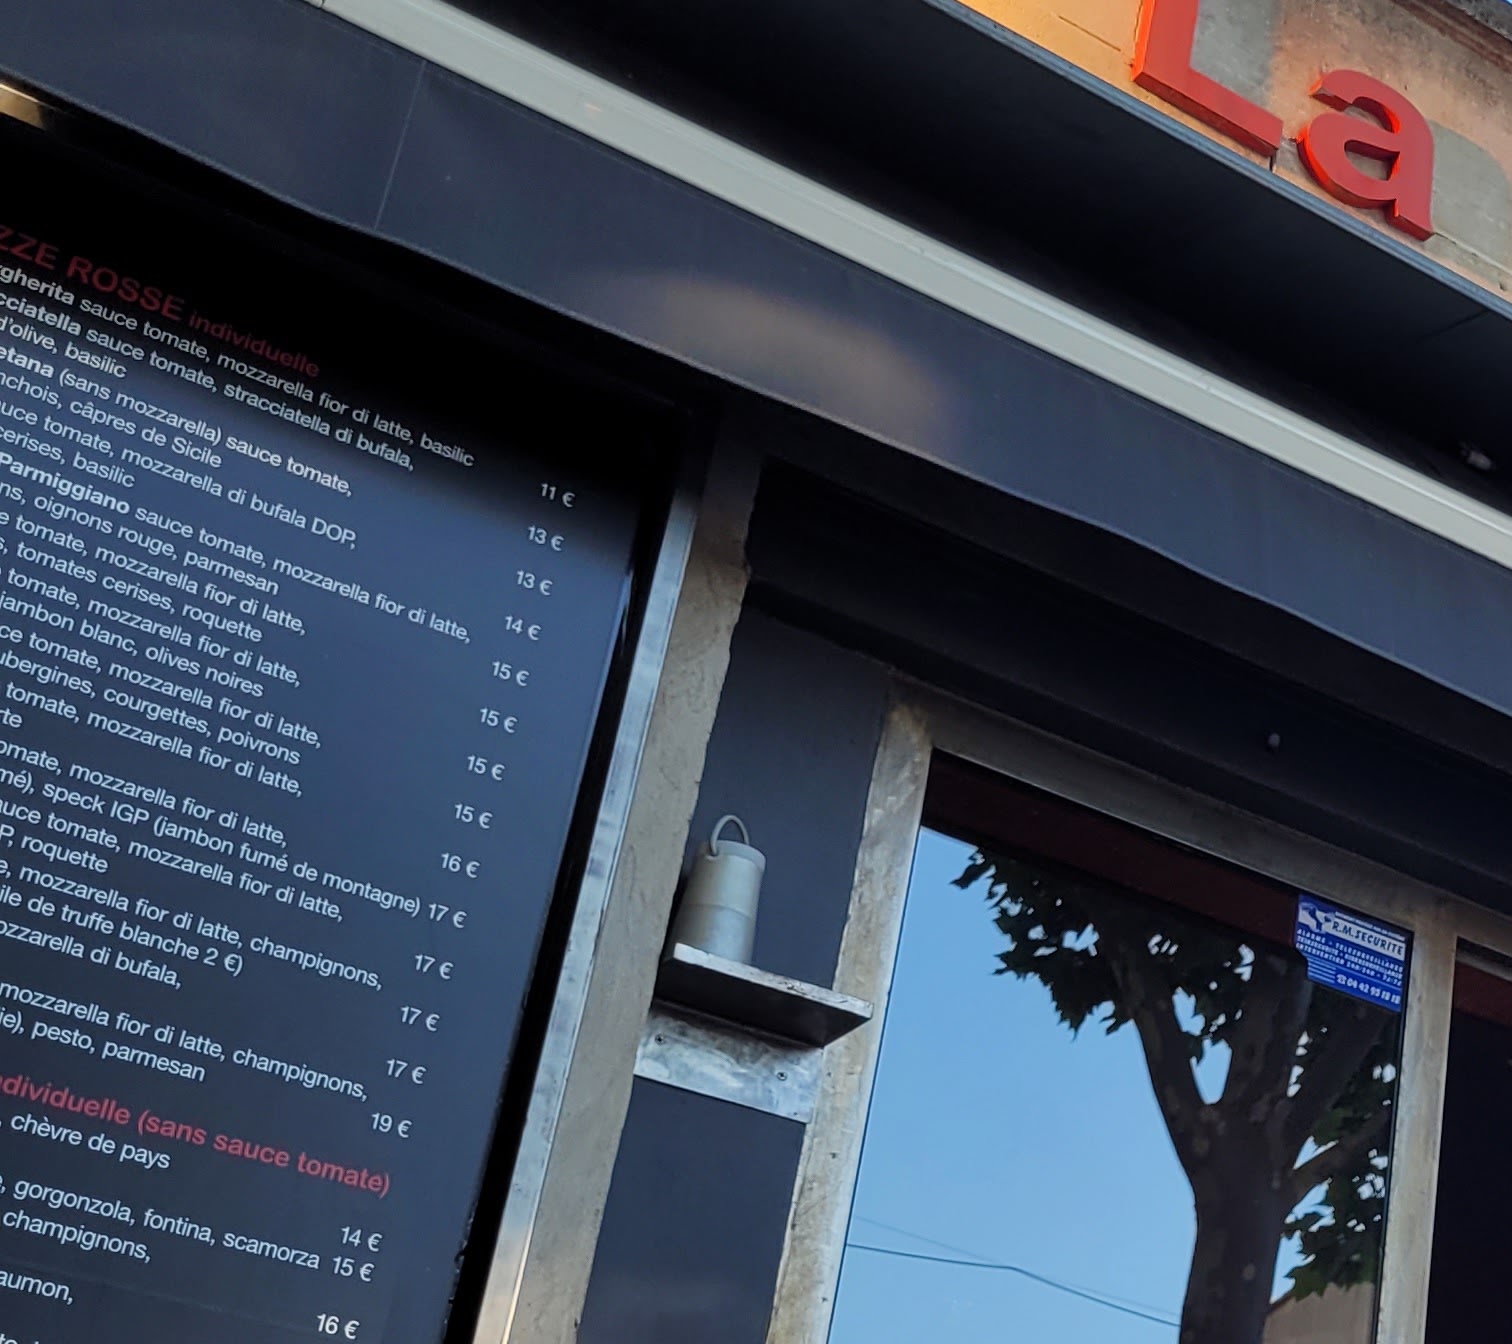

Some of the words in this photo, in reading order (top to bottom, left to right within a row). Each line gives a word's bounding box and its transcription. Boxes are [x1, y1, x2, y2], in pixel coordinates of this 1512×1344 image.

[65, 255, 185, 322] ROSSE
[63, 339, 128, 379] basilic
[78, 297, 139, 332] sauce
[142, 319, 211, 364] tomate,
[216, 352, 315, 404] mozzarella
[317, 390, 351, 416] fior
[351, 406, 372, 426] di
[372, 412, 415, 447] latte,
[419, 431, 476, 468] basilic
[58, 366, 113, 401] (sans
[113, 390, 223, 448] mozzarella)
[224, 434, 283, 468] sauce
[285, 454, 353, 499] tomate,
[68, 399, 138, 436] câpres
[140, 425, 168, 448] de
[170, 435, 223, 469] Sicile
[84, 327, 146, 362] sauce
[148, 349, 218, 394] tomate,
[222, 382, 332, 438] stracciatella
[333, 425, 355, 446] di
[355, 431, 415, 473] bufala,
[540, 481, 558, 502] 11
[561, 490, 576, 509] €
[0, 450, 131, 516] Parmiggiano
[133, 506, 195, 540] sauce
[197, 526, 267, 570] tomate,
[271, 557, 371, 606] mozzarella
[373, 591, 407, 617] fior
[407, 606, 428, 626] di
[428, 611, 471, 645] latte,
[33, 494, 114, 535] oignons
[116, 524, 178, 562] rouge,
[181, 549, 280, 597] parmesan
[527, 523, 548, 546] 13
[549, 534, 565, 553] €
[15, 540, 99, 585] tomates
[101, 574, 177, 616] cerises,
[181, 602, 264, 644] roquette
[78, 617, 139, 658] blanc,
[144, 644, 202, 677] olives
[203, 665, 265, 699] noires
[491, 659, 513, 681] 15
[515, 669, 531, 688] €
[102, 687, 213, 739] courgettes,
[216, 725, 302, 766] poivrons
[41, 781, 107, 816] speck
[108, 798, 151, 826] IGP
[152, 813, 235, 857] (jambon
[238, 841, 289, 873] fumé
[291, 860, 319, 883] de
[321, 871, 422, 919] montagne)
[427, 902, 451, 923] 17
[451, 909, 468, 930] €
[440, 851, 463, 874] 16
[465, 859, 481, 880] €
[18, 864, 130, 914] mozzarella
[133, 896, 171, 924] fior
[171, 910, 195, 932] di
[195, 915, 244, 951] latte,
[249, 934, 383, 993] champignons,
[26, 894, 57, 918] de
[60, 902, 116, 936] truffe
[117, 919, 201, 962] blanche
[202, 946, 220, 968] 2
[414, 953, 437, 974] 17
[438, 960, 455, 981] €
[29, 1019, 96, 1056] pesto,
[100, 1039, 207, 1084] parmesan
[9, 1112, 84, 1147] chèvre
[86, 1131, 117, 1156] de
[118, 1142, 172, 1171] pays
[137, 1109, 208, 1146] (sans
[212, 1134, 290, 1168] sauce
[297, 1151, 390, 1199] tomate)
[370, 1111, 394, 1134] 19
[396, 1118, 414, 1140] €
[1, 1208, 152, 1265] champignons,
[11, 1179, 137, 1228] gorgonzola,
[142, 1207, 217, 1248] fontina,
[221, 1231, 321, 1271] scamorza
[331, 1254, 356, 1278] 15
[358, 1261, 376, 1284] €
